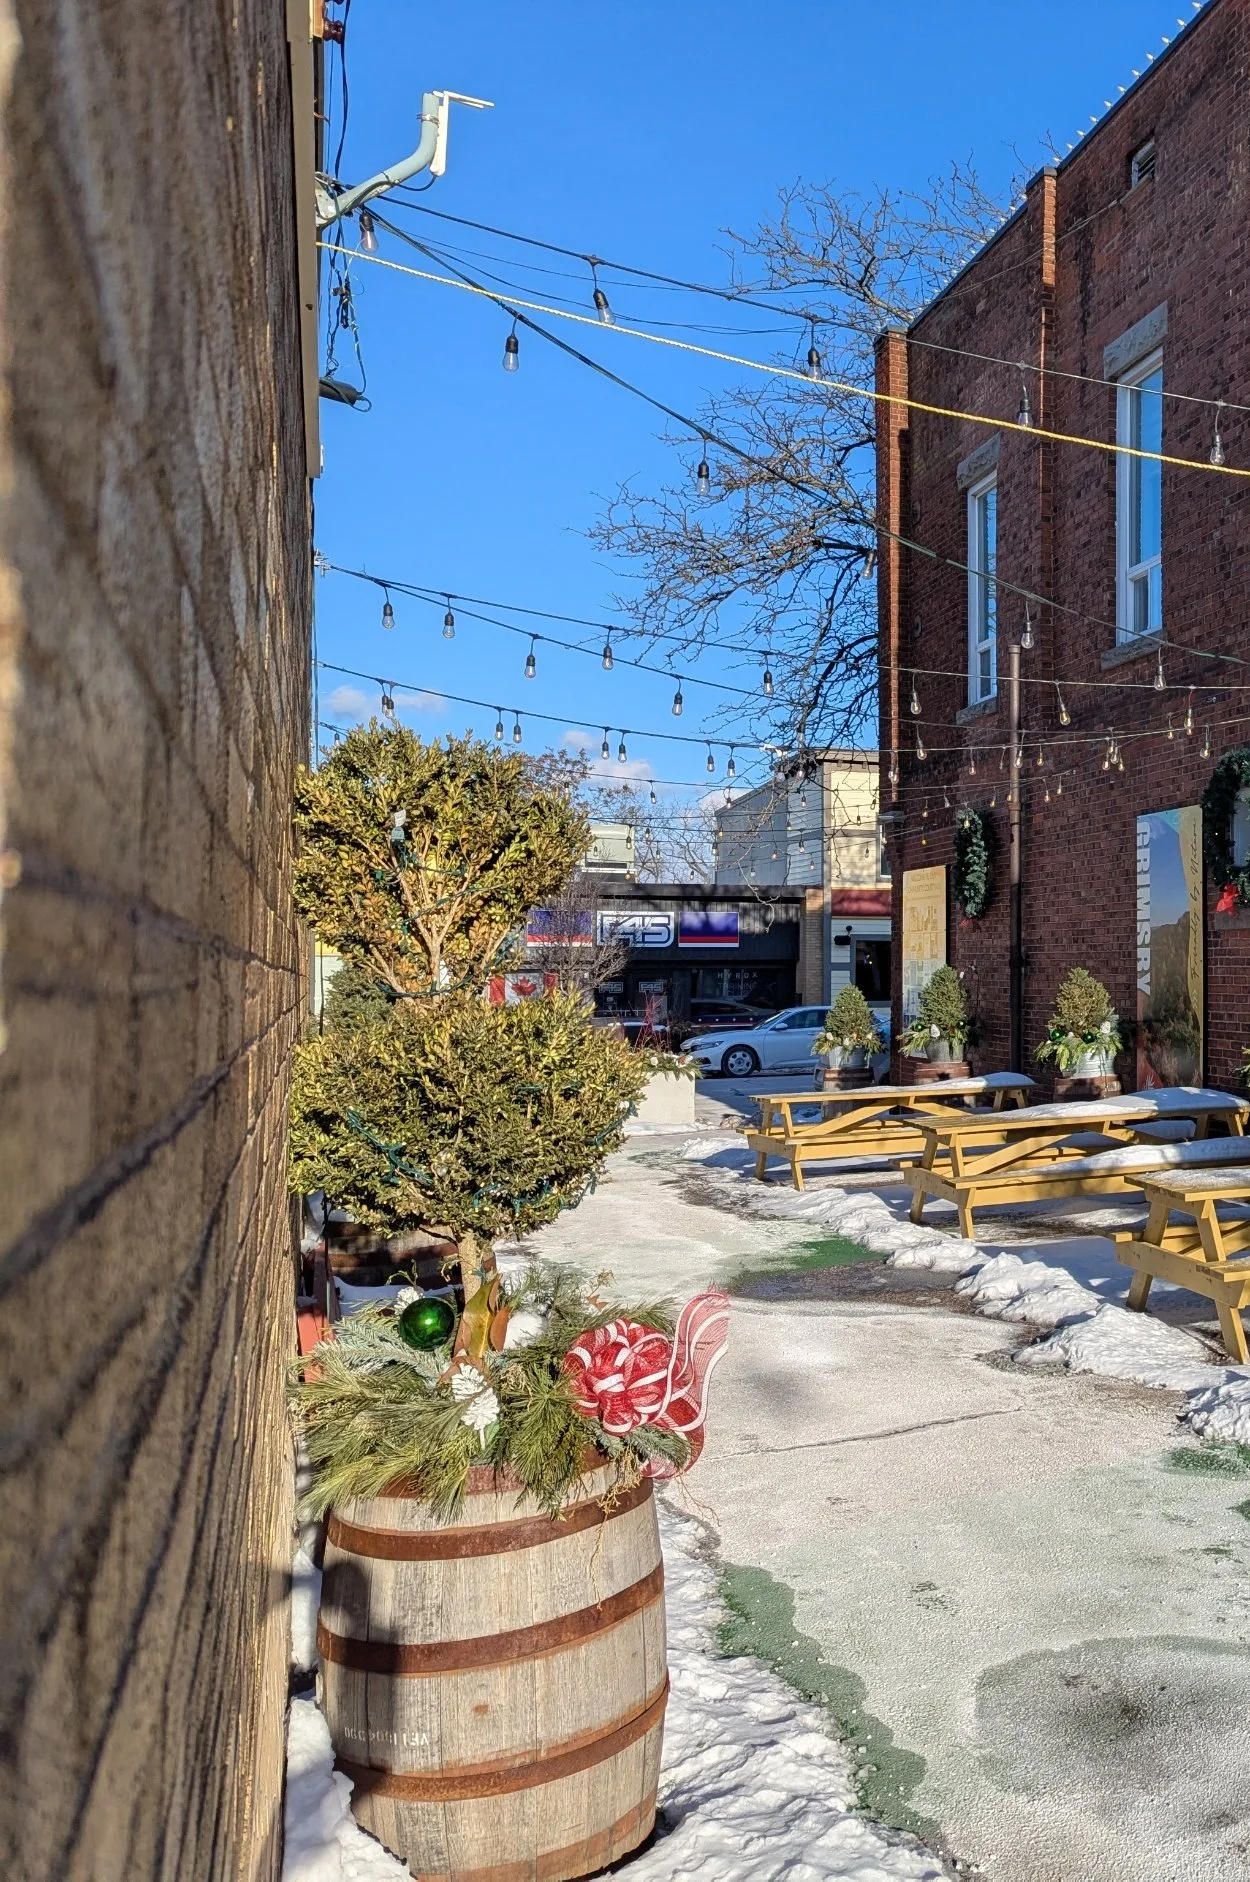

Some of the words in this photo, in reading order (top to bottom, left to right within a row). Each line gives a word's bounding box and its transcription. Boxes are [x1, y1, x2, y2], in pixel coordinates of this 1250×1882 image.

[599, 913, 672, 945] F45
[717, 971, 758, 979] HYROX
[639, 982, 663, 993] F45
